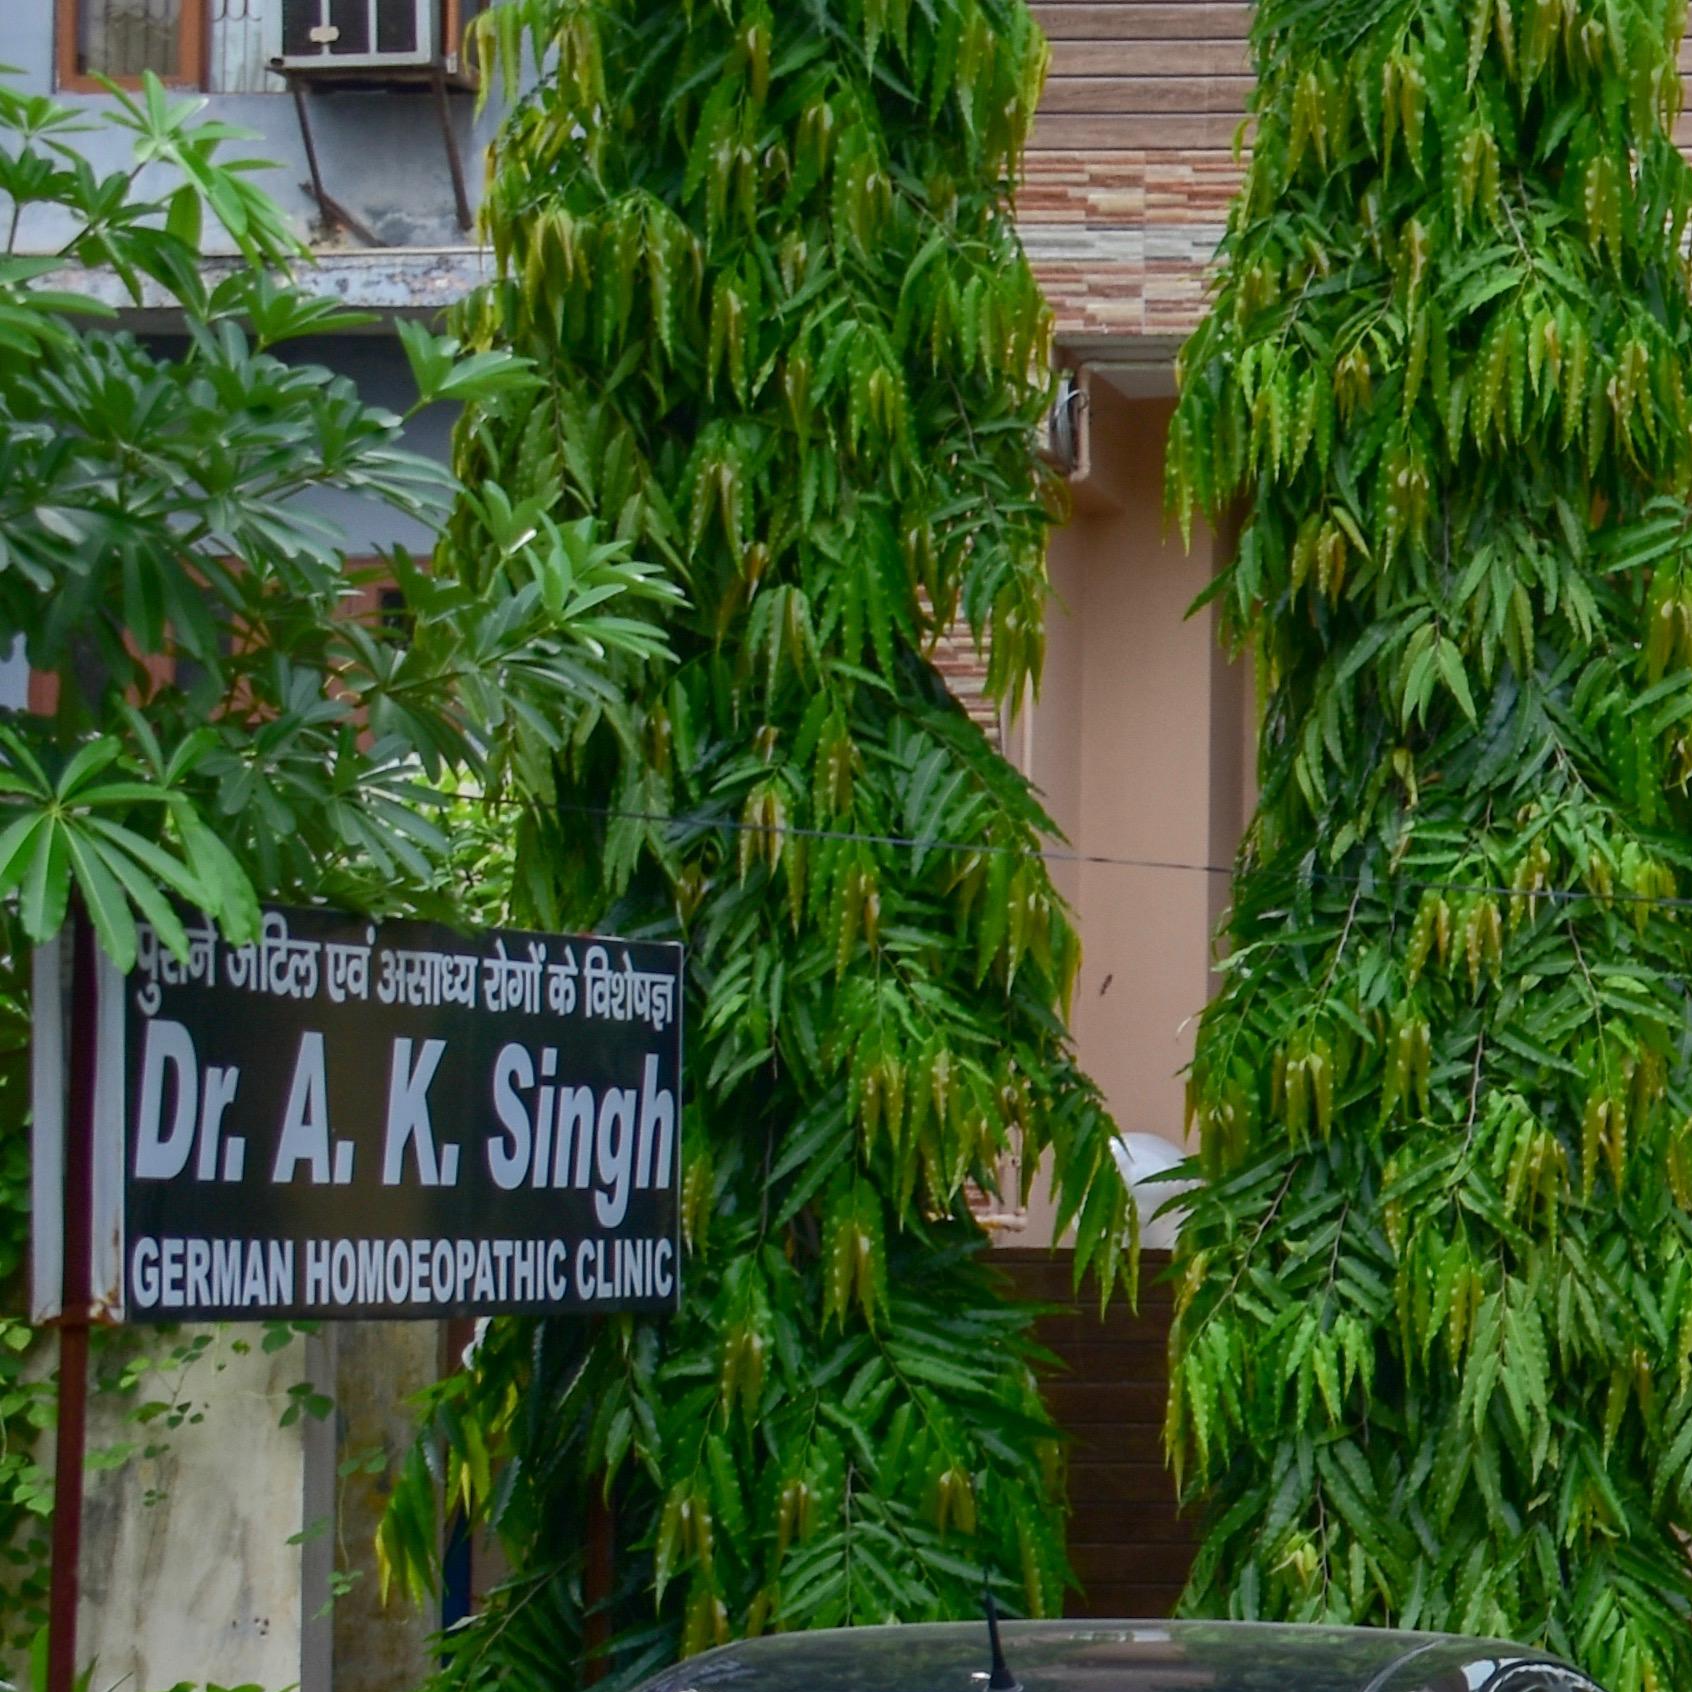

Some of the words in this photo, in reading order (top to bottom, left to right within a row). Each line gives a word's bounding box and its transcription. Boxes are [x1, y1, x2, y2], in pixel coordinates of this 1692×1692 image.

[326, 925, 375, 1003] एवं
[377, 949, 478, 1009] असाध्य
[483, 937, 546, 1014] रोगों
[548, 944, 578, 1016] के
[584, 945, 675, 1031] विशेषज्ञ
[135, 1019, 246, 1182] Dr.
[272, 1031, 356, 1184] A.
[382, 1037, 461, 1186] K.
[487, 1042, 675, 1229] Singh
[132, 1238, 295, 1308] GERMAN
[305, 1238, 568, 1307] HOMOEOPATHIC
[575, 1238, 674, 1299] CLINIC
